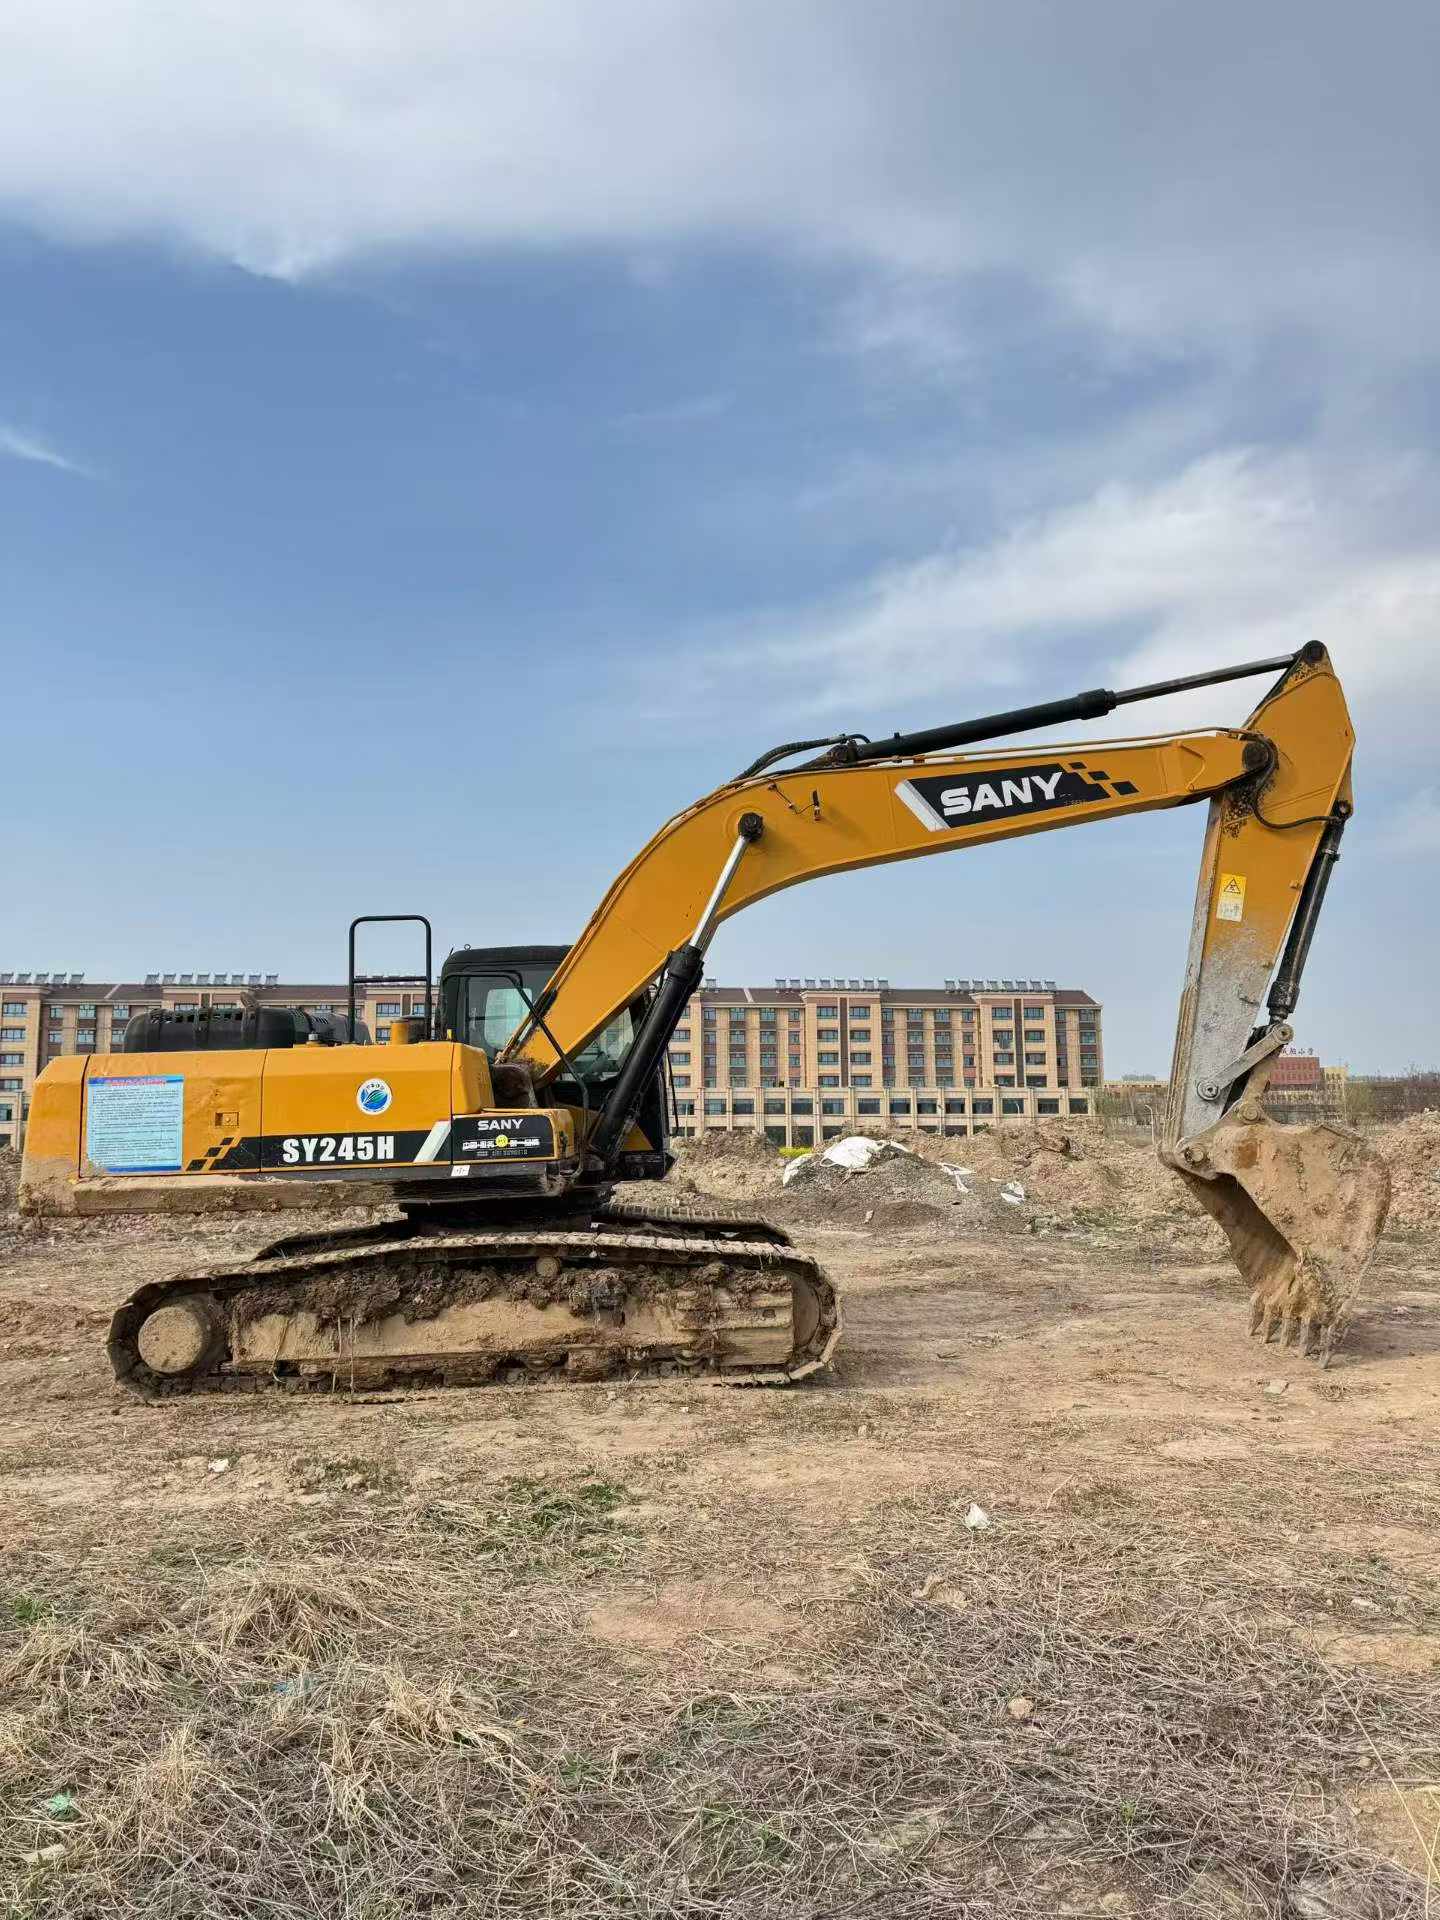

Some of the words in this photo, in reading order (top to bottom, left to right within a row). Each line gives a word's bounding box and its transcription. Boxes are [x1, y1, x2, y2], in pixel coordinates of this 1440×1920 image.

[940, 772, 1063, 816] SANY
[477, 1119, 523, 1131] SANY
[282, 1135, 395, 1163] SY245H
